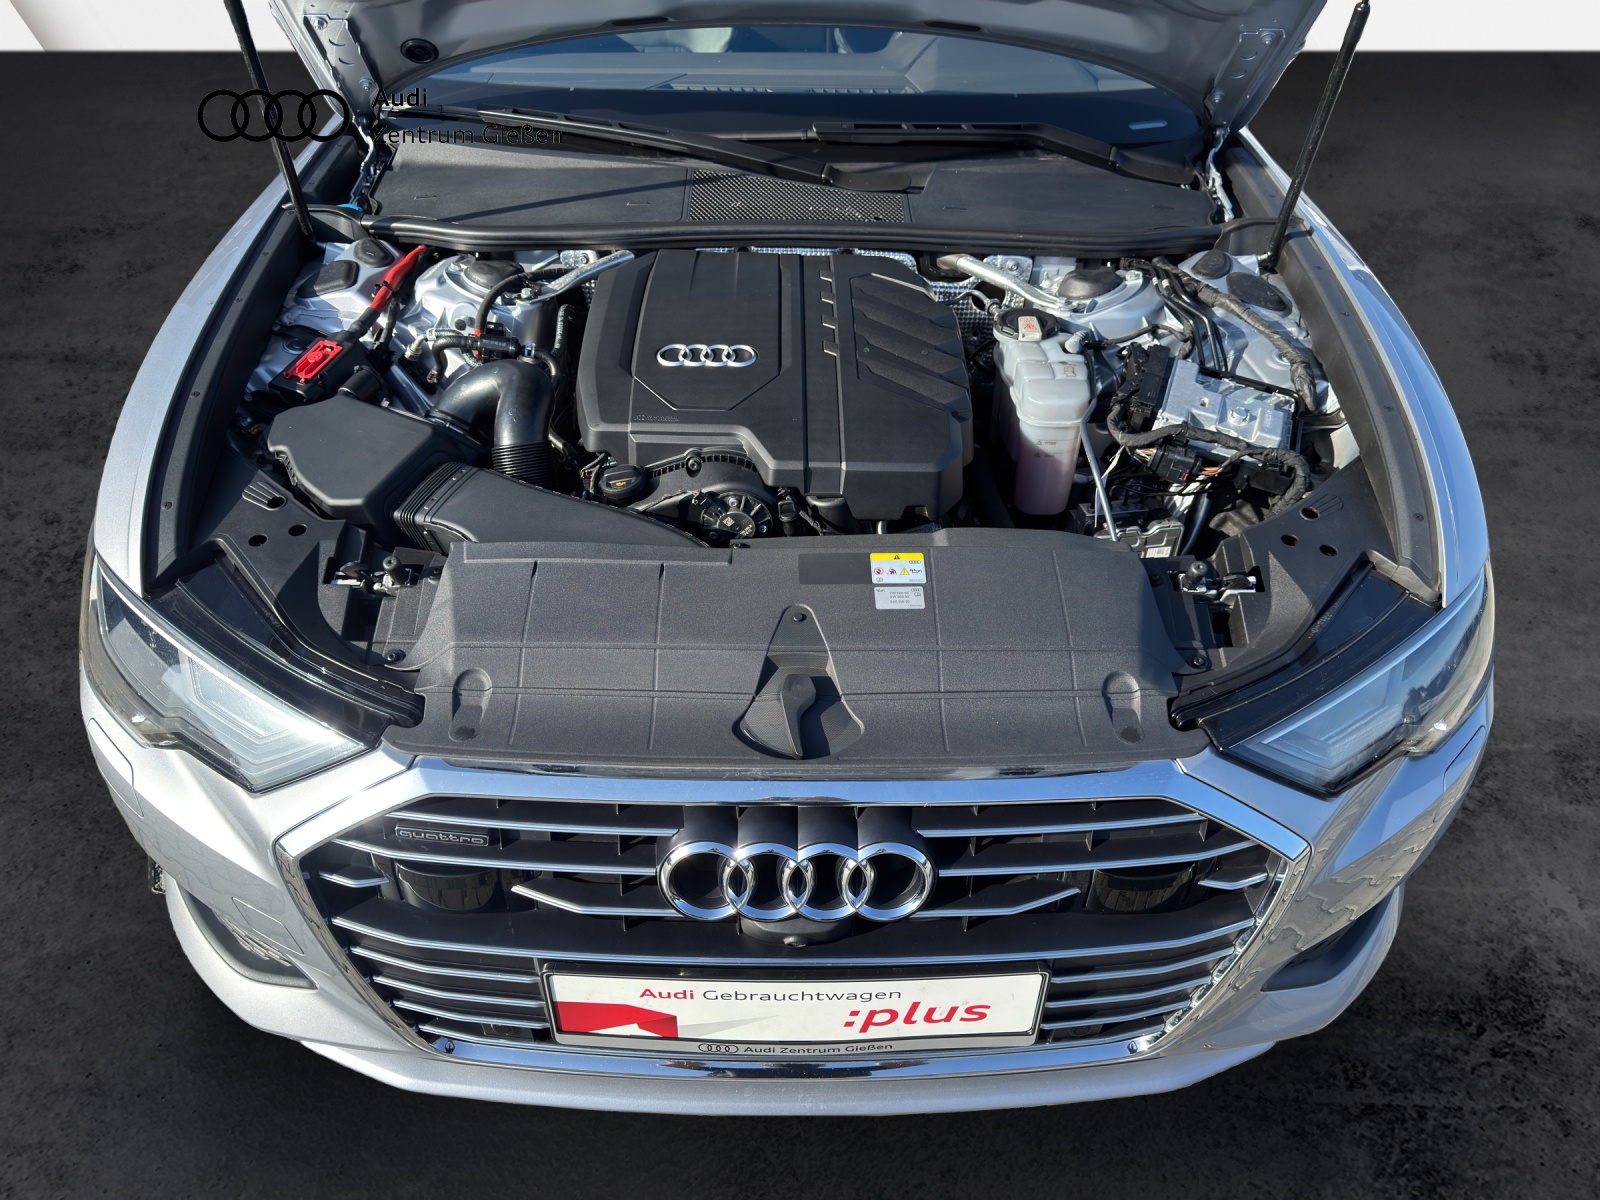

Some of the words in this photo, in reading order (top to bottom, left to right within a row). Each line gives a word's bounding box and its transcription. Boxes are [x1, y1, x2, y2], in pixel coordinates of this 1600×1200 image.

[400, 831, 484, 844] quattro
[639, 989, 695, 1000] Audi
[702, 990, 902, 1002] Gebrauchtwagen
[743, 1046, 776, 1054] Audi
[845, 1044, 893, 1052] Gießen
